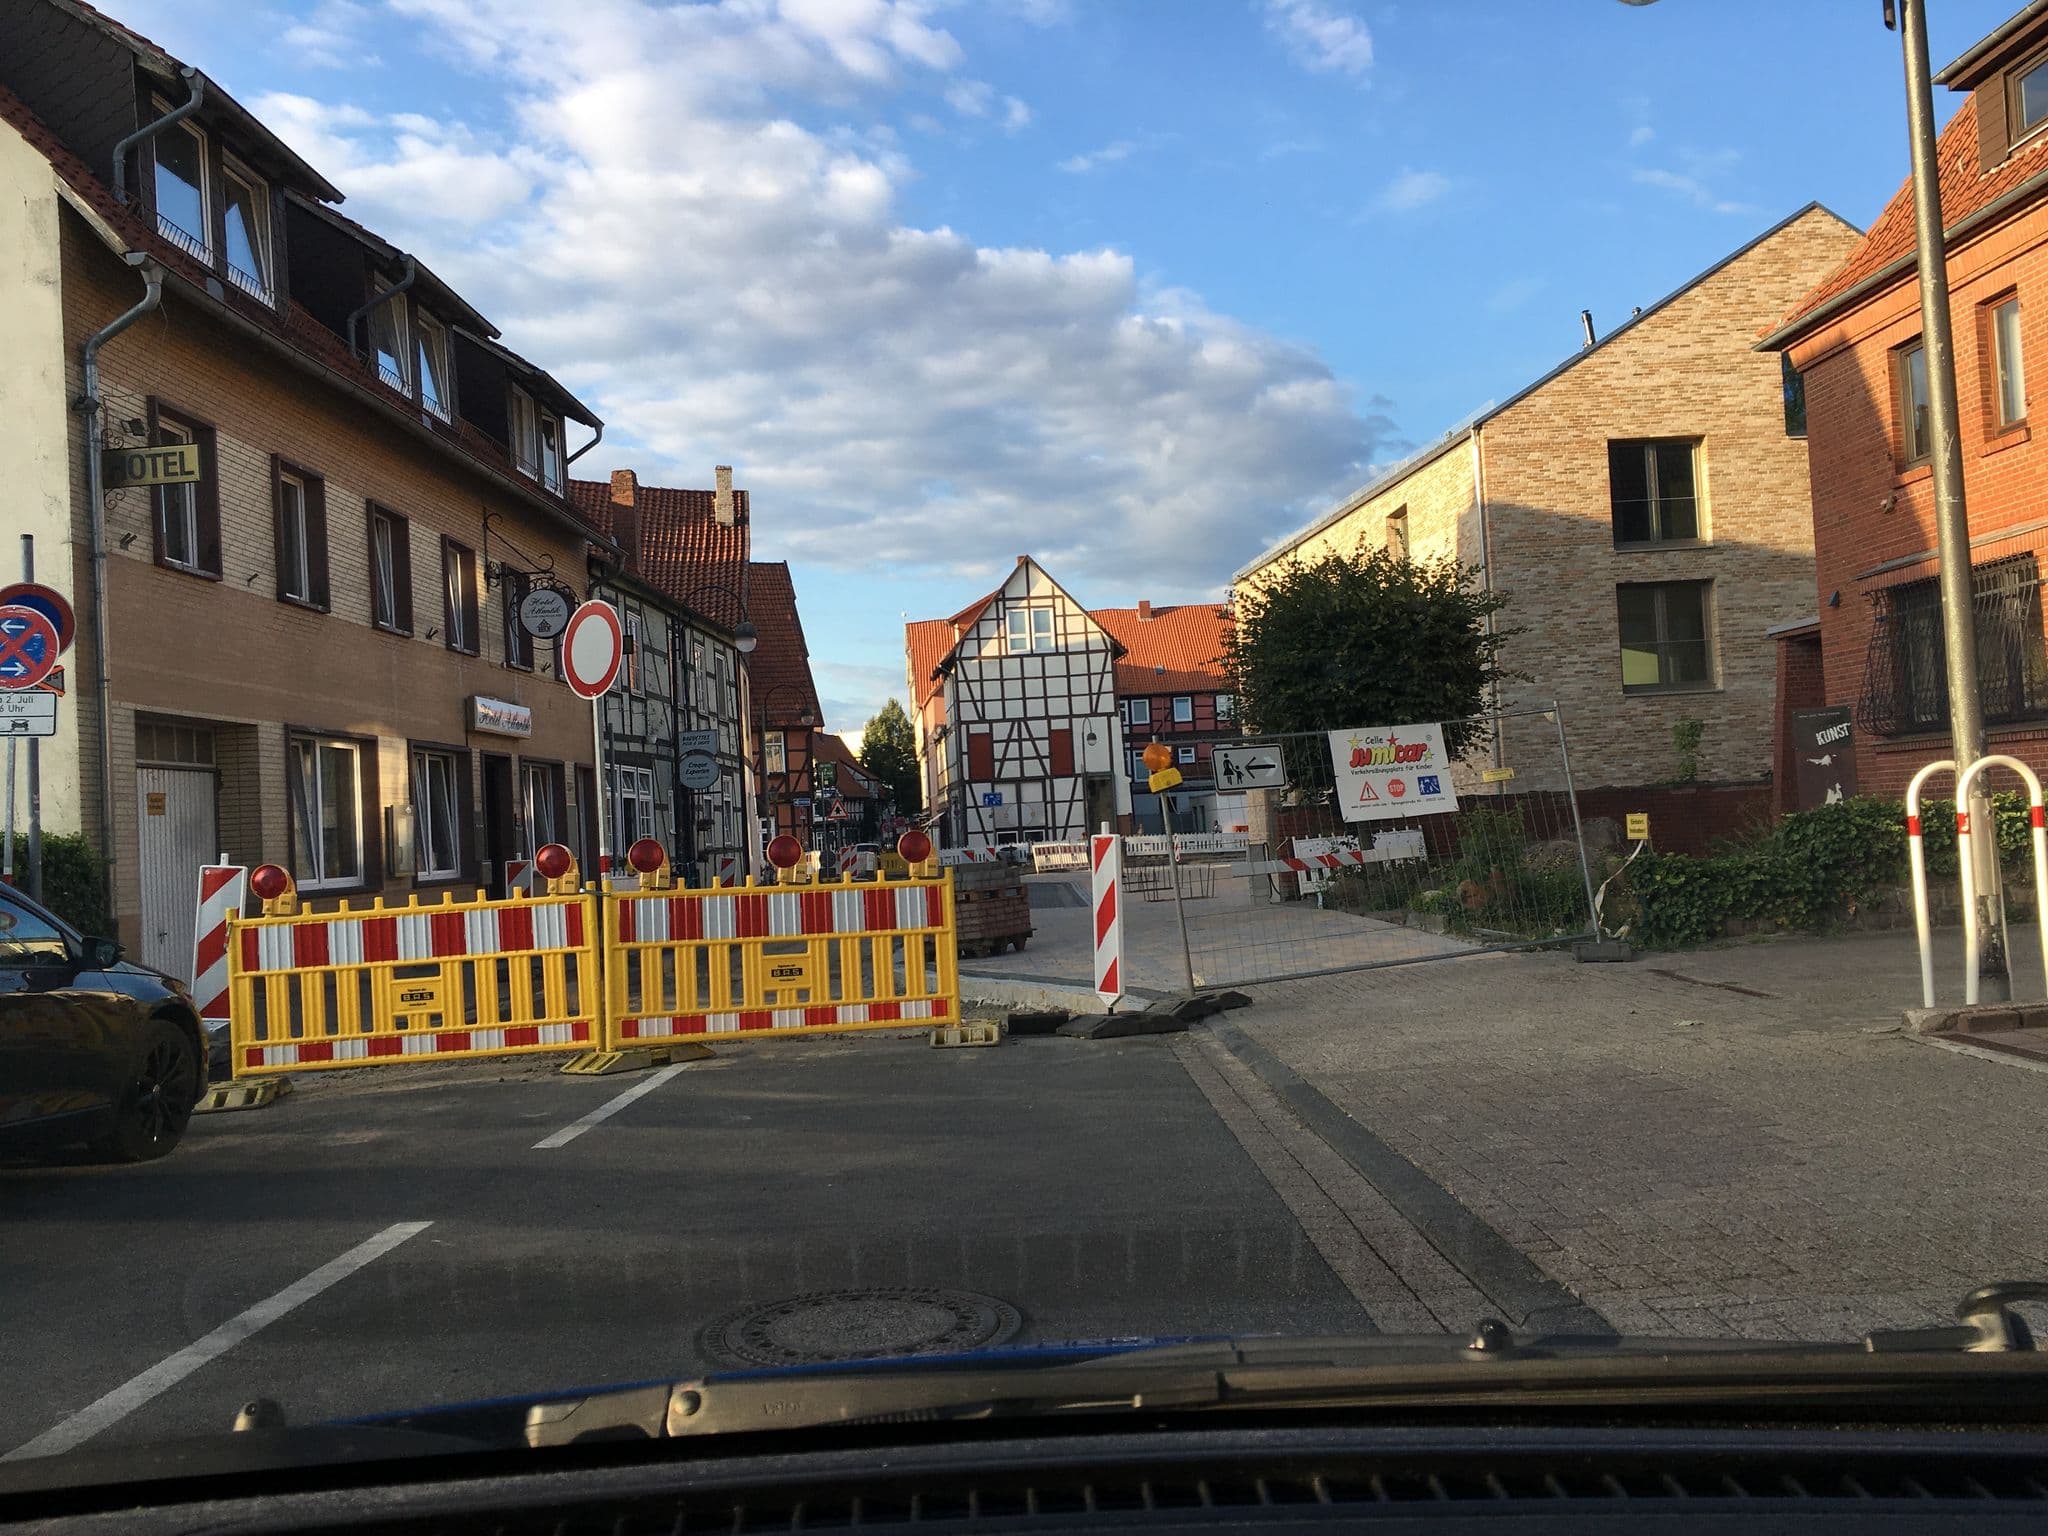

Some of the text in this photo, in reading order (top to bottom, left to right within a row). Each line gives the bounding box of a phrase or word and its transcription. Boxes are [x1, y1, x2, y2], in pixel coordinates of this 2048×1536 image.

[17, 695, 34, 703] Juli
[8, 704, 25, 712] Uhr
[1815, 722, 1851, 745] KUNST
[1365, 736, 1384, 745] Celle
[1389, 783, 1405, 793] STOP
